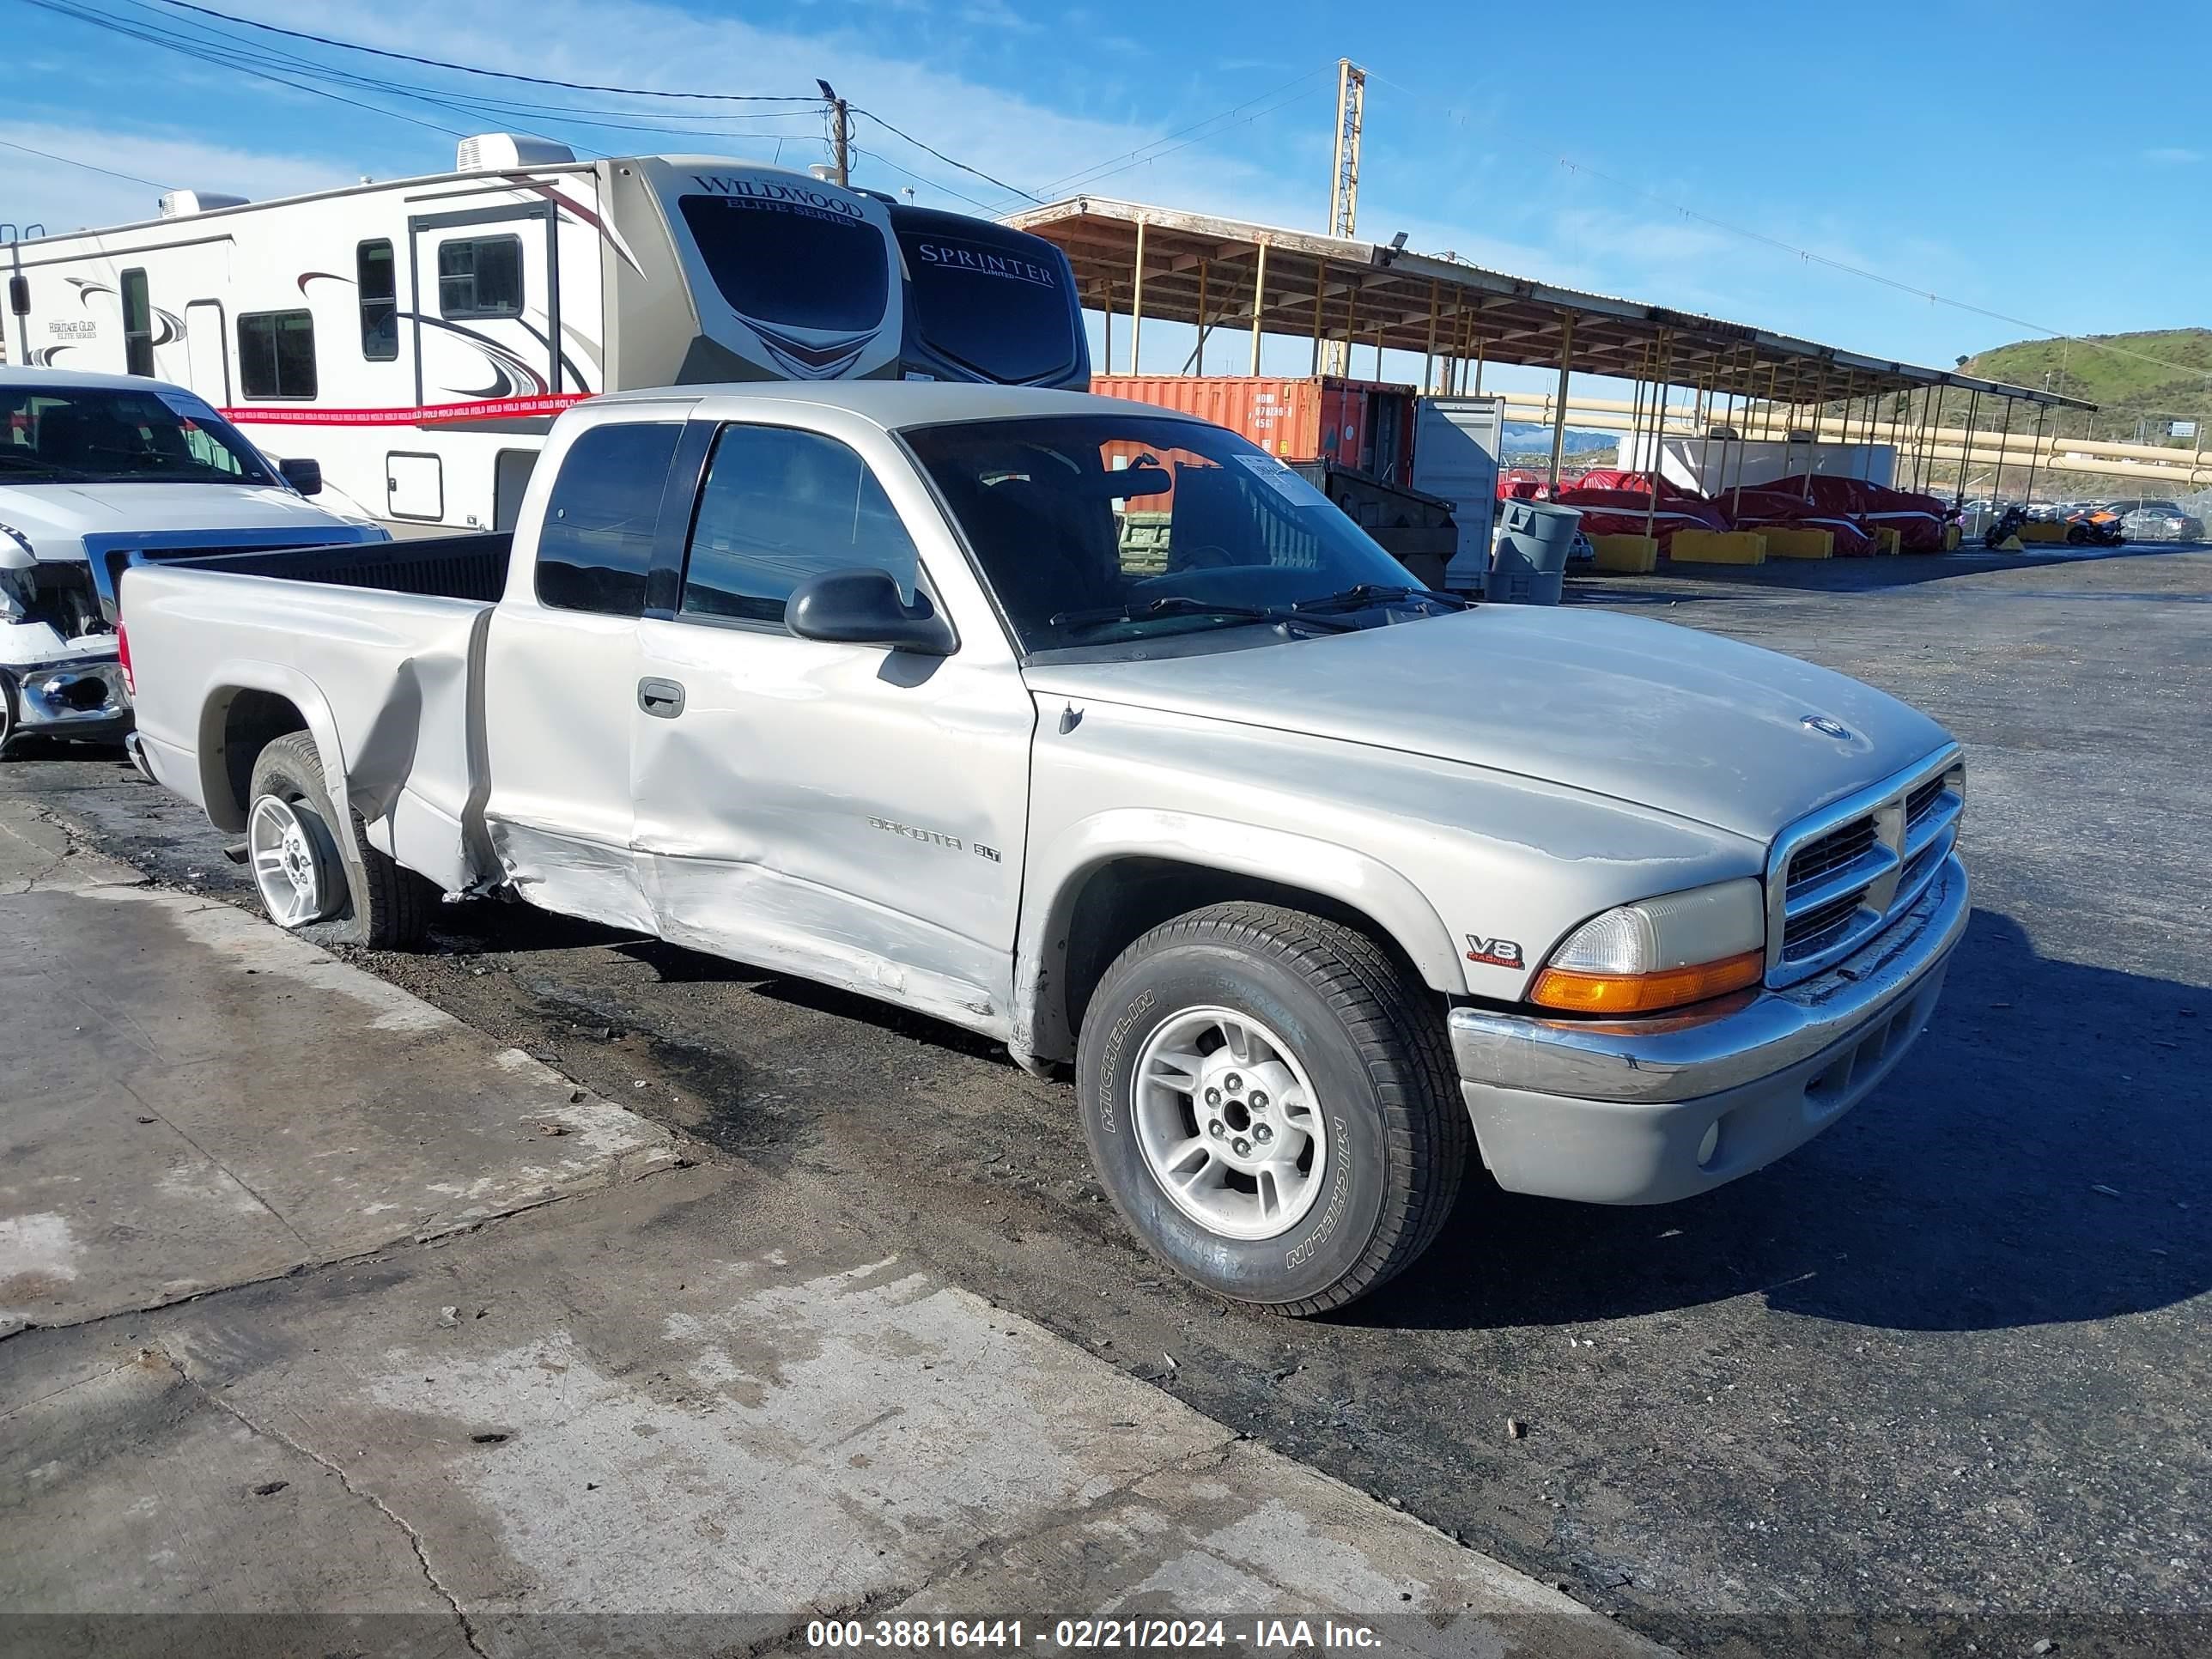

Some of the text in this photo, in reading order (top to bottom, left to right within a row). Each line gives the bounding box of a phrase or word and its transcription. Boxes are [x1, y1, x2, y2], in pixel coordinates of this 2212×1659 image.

[692, 176, 864, 218] WILDWOOD
[726, 198, 857, 228] ELITE SERIES
[920, 245, 1055, 284] SPRINTER
[79, 320, 96, 331] GLEN
[471, 405, 486, 415] HOLD
[486, 404, 502, 413] HOLD
[503, 403, 520, 411] HOLD
[520, 402, 537, 410] HOLD
[538, 400, 554, 409] HOLD
[866, 815, 1000, 863] DAKOTA SLT
[1465, 933, 1521, 960] V8
[1468, 952, 1520, 967] MAGNUM
[1099, 988, 1157, 1133] MICHELIN
[1285, 1116, 1352, 1269] MICHELIN
